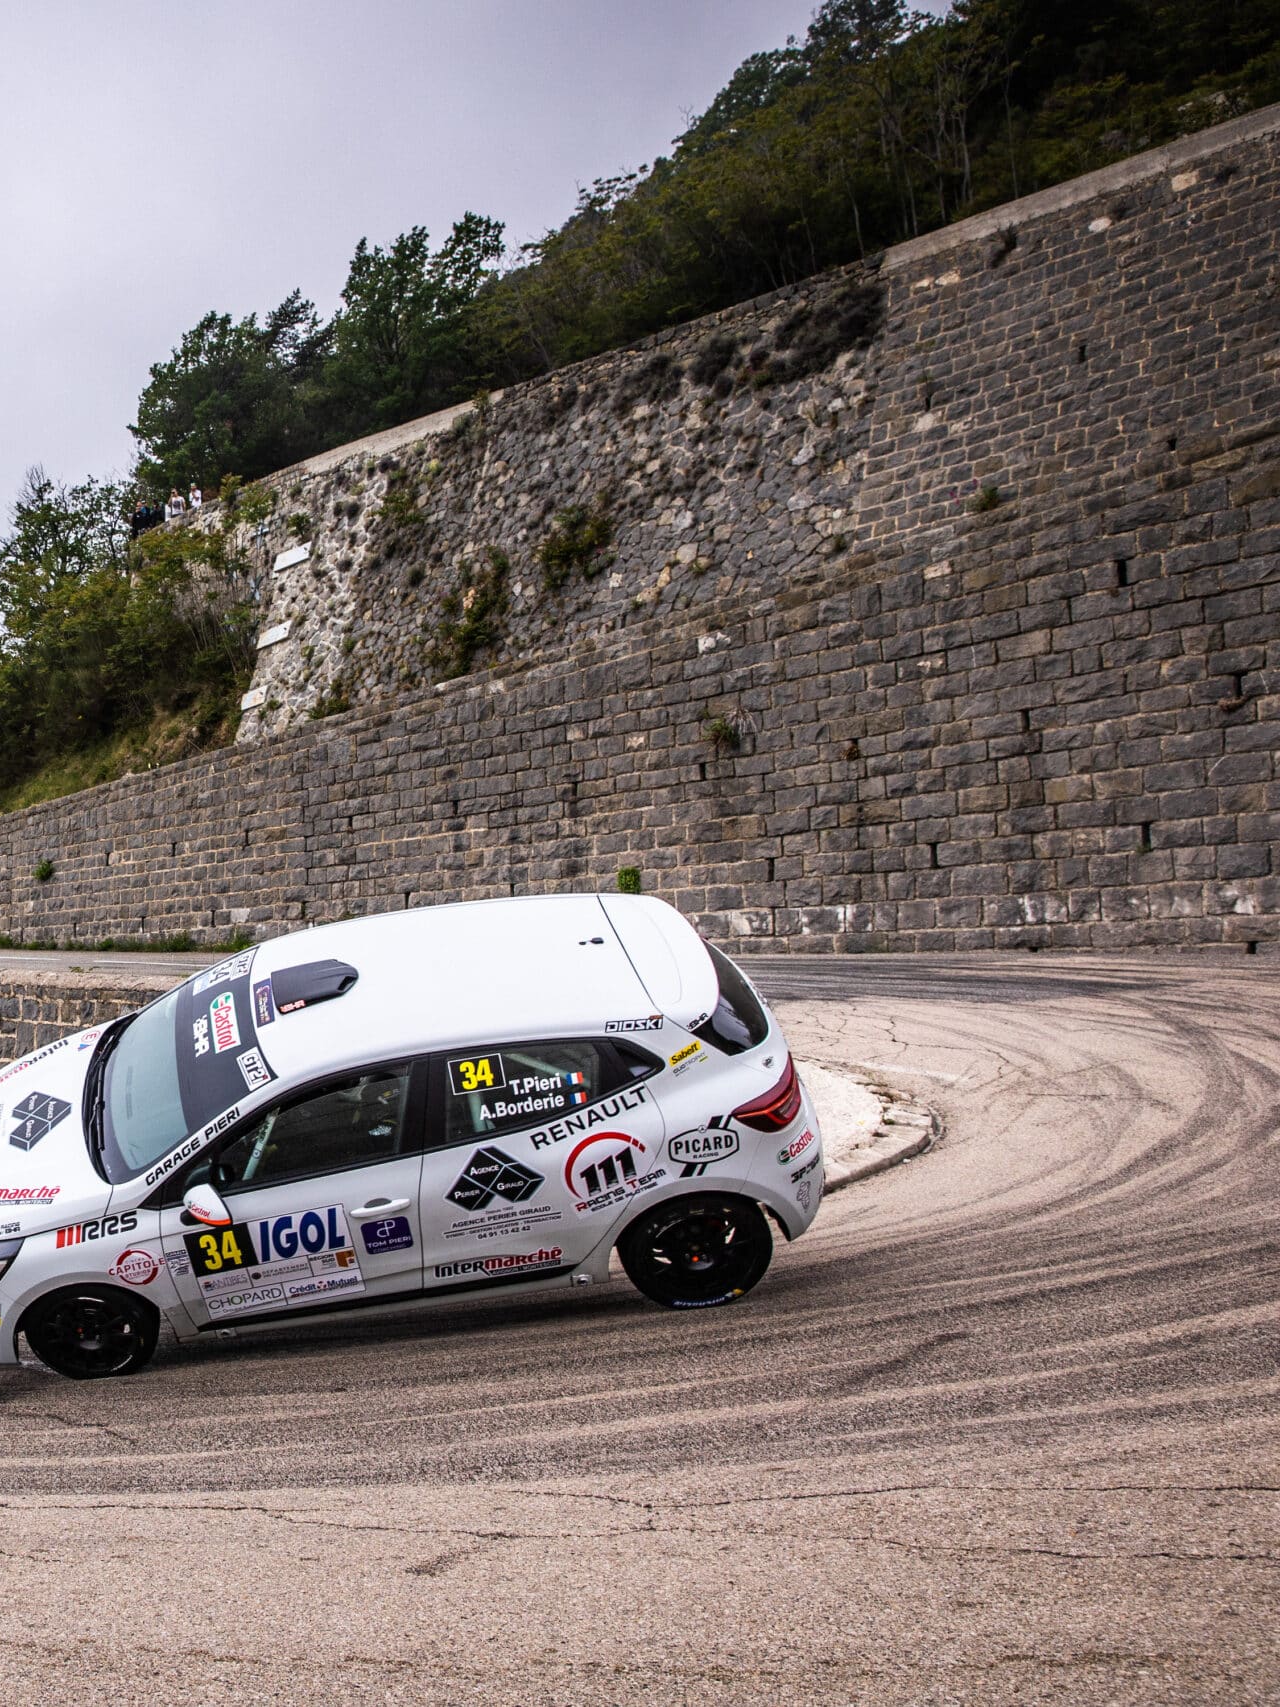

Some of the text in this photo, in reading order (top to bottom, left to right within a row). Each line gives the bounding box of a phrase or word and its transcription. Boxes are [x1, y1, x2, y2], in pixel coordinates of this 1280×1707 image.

[213, 1005, 237, 1051] Castrol
[671, 1042, 700, 1065] Sabelt
[459, 1058, 495, 1091] 34
[509, 1073, 562, 1095] T.Pieri
[479, 1094, 565, 1121] A.Borderie
[530, 1086, 647, 1150] RENAULT
[145, 1137, 201, 1186] GARAGE
[204, 1106, 240, 1140] PIERI
[674, 1135, 734, 1155] PICARD
[789, 1128, 814, 1157] Castrol
[692, 1151, 719, 1159] RACING
[470, 1165, 500, 1176] AGENCE
[580, 1146, 637, 1197] 111
[454, 1189, 480, 1199] PERIER
[496, 1181, 524, 1191] GIRAUD
[575, 1168, 667, 1212] RACING TEAM
[191, 1204, 211, 1218] Castrol
[452, 1217, 486, 1229] AGENCE
[487, 1211, 517, 1222] PERIER
[518, 1205, 551, 1216] GIRAUD
[81, 1210, 138, 1243] RRS
[259, 1208, 345, 1263] IGOL
[199, 1231, 243, 1271] 34
[367, 1236, 411, 1248] TOM PIERI
[108, 1257, 166, 1276] CAPITOLE
[289, 1283, 317, 1294] Crédit
[327, 1276, 358, 1290] Mutuel
[208, 1287, 282, 1310] CHOPARD
